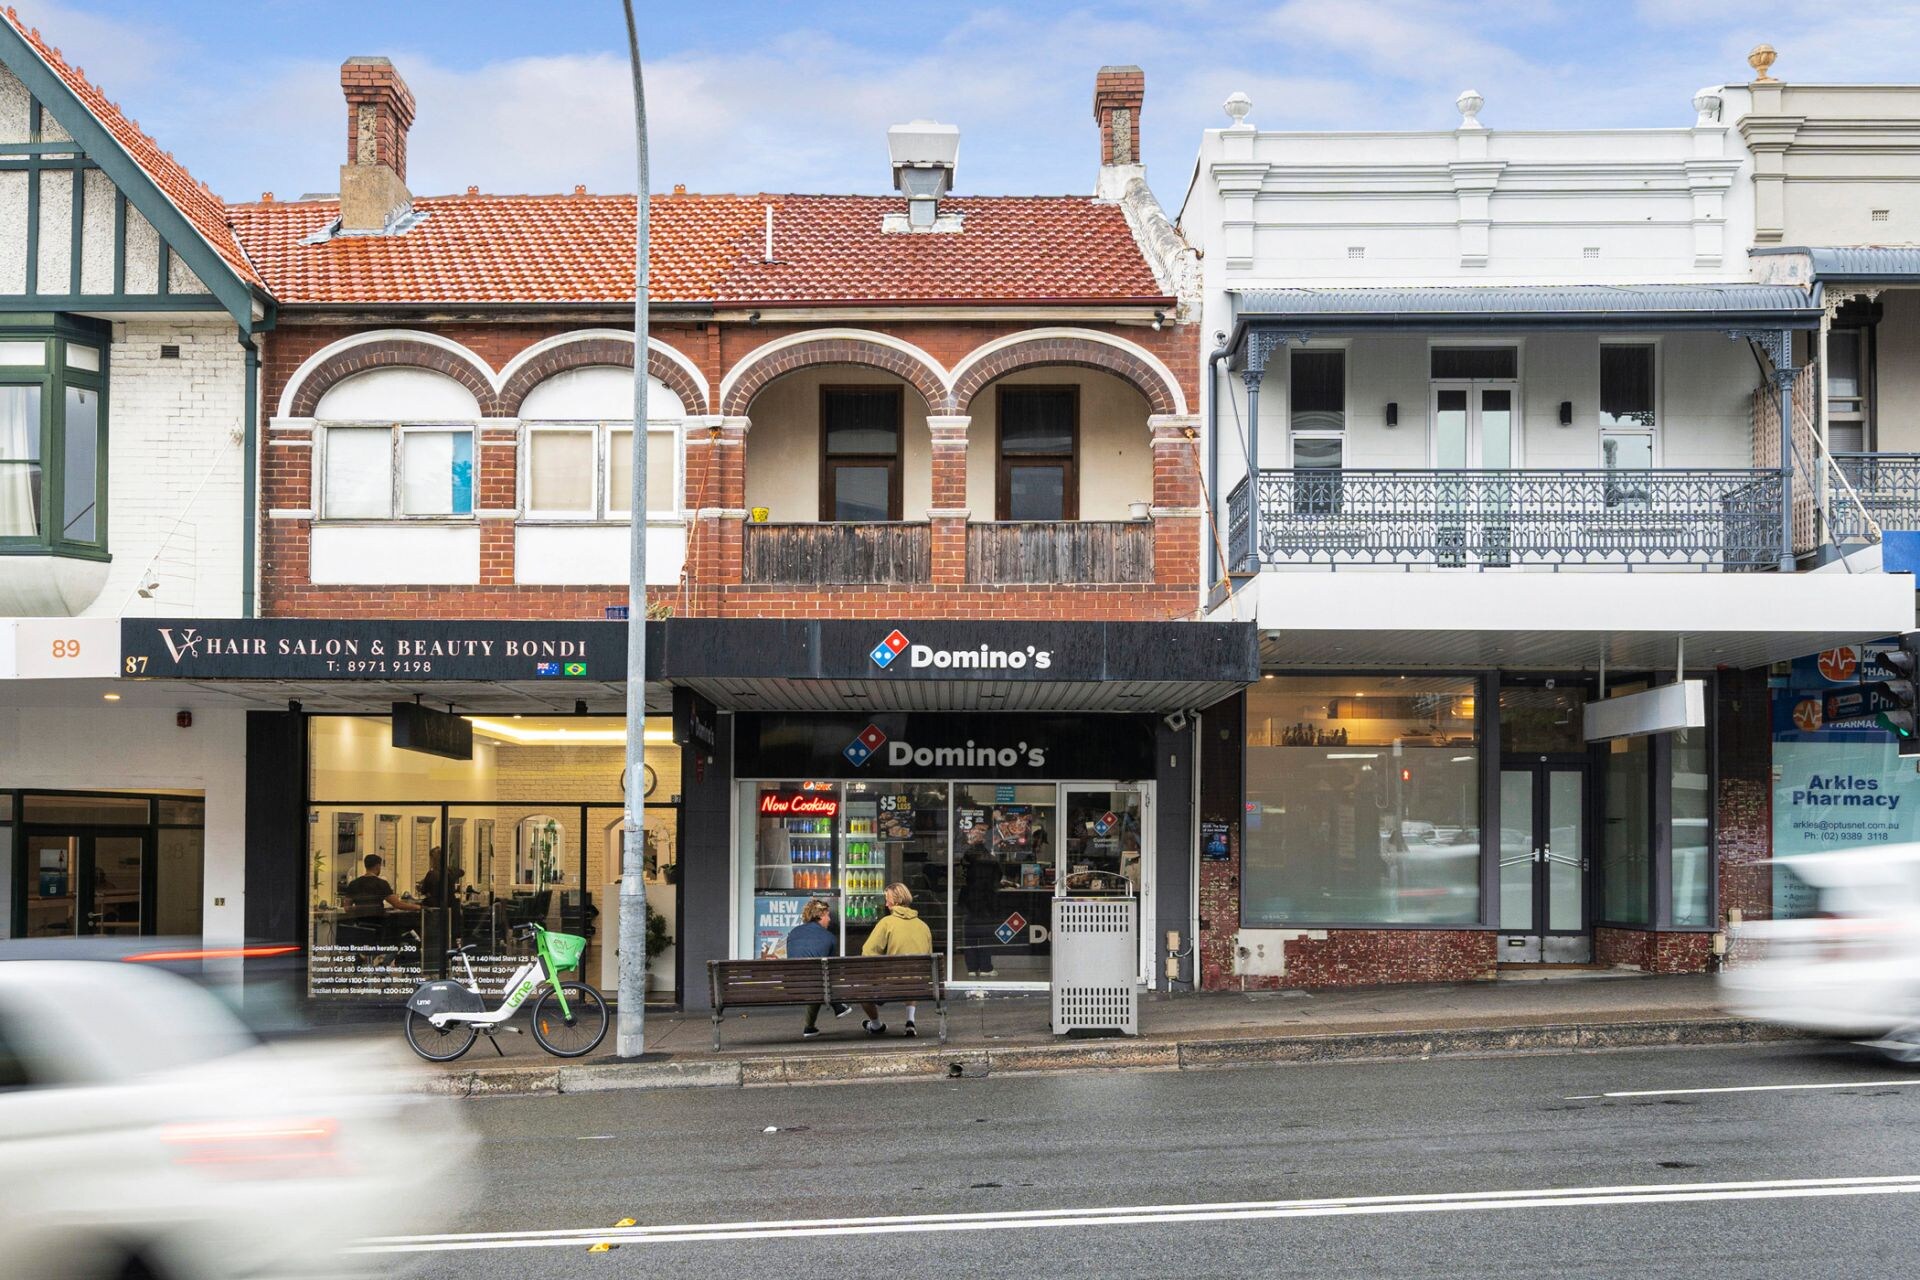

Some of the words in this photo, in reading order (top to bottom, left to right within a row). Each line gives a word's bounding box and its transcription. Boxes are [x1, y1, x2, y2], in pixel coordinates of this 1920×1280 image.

[52, 639, 80, 658] 89
[207, 639, 267, 655] HAIR
[279, 639, 359, 655] SALON
[371, 640, 385, 655] &
[398, 640, 494, 656] BEAUTY
[506, 641, 586, 657] BONDI
[911, 644, 1051, 669] Domino's
[125, 656, 148, 673] 87
[327, 660, 340, 672] T:
[347, 661, 386, 672] 8971
[393, 661, 431, 673] 9198
[888, 739, 1045, 767] Domino's
[1809, 775, 1878, 790] Arkles
[762, 795, 788, 811] Now
[791, 795, 836, 816] Cooking
[880, 795, 897, 811] $5
[896, 795, 907, 803] OR
[1793, 790, 1900, 810] Pharmacy
[959, 816, 973, 830] $5
[1793, 821, 1899, 831] arkles@optusnet.com.au
[1804, 832, 1818, 840] Ph:
[1821, 832, 1838, 841] (02)
[1840, 832, 1862, 840] 9389
[1867, 832, 1888, 840] 3118
[769, 901, 799, 913] NEW
[311, 944, 333, 953] Special
[350, 944, 376, 952] Brazilian
[761, 937, 780, 955] $7
[507, 981, 533, 1008] Lime
